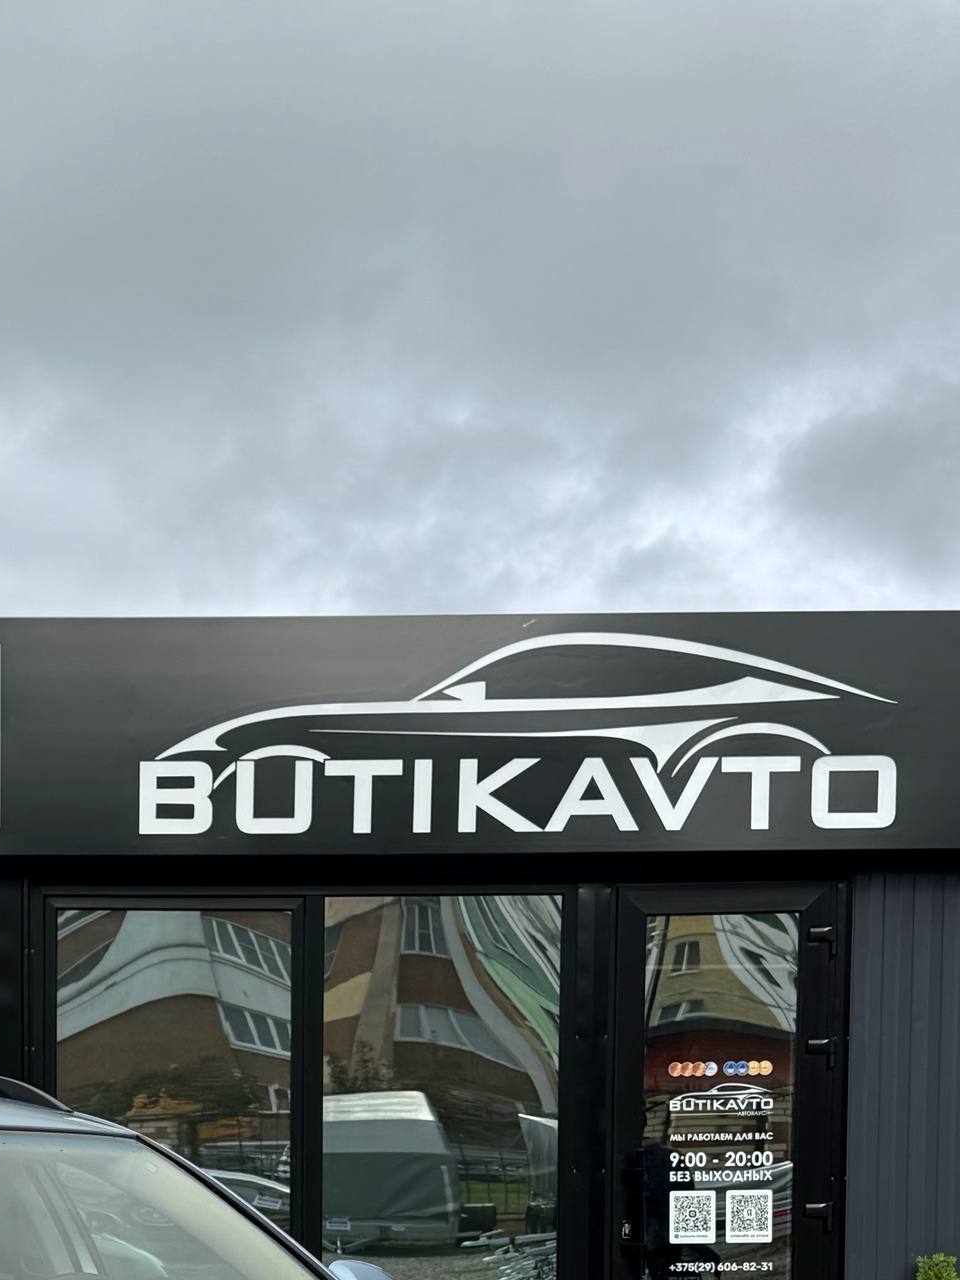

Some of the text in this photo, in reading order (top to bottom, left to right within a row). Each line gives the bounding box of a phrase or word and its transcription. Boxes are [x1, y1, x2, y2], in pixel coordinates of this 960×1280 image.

[140, 755, 897, 835] BUTIKAVTO
[669, 1098, 774, 1111] BUTIKAVTO
[669, 1132, 774, 1142] МЫ РАБОТАЕМ ДЛЯ ВАС
[669, 1152, 707, 1168] 9:00
[724, 1151, 774, 1167] 20:00
[669, 1170, 773, 1182] БЕЗ ВЫХОДНЫХ
[668, 1261, 774, 1273] +375(29) 606-82-31
